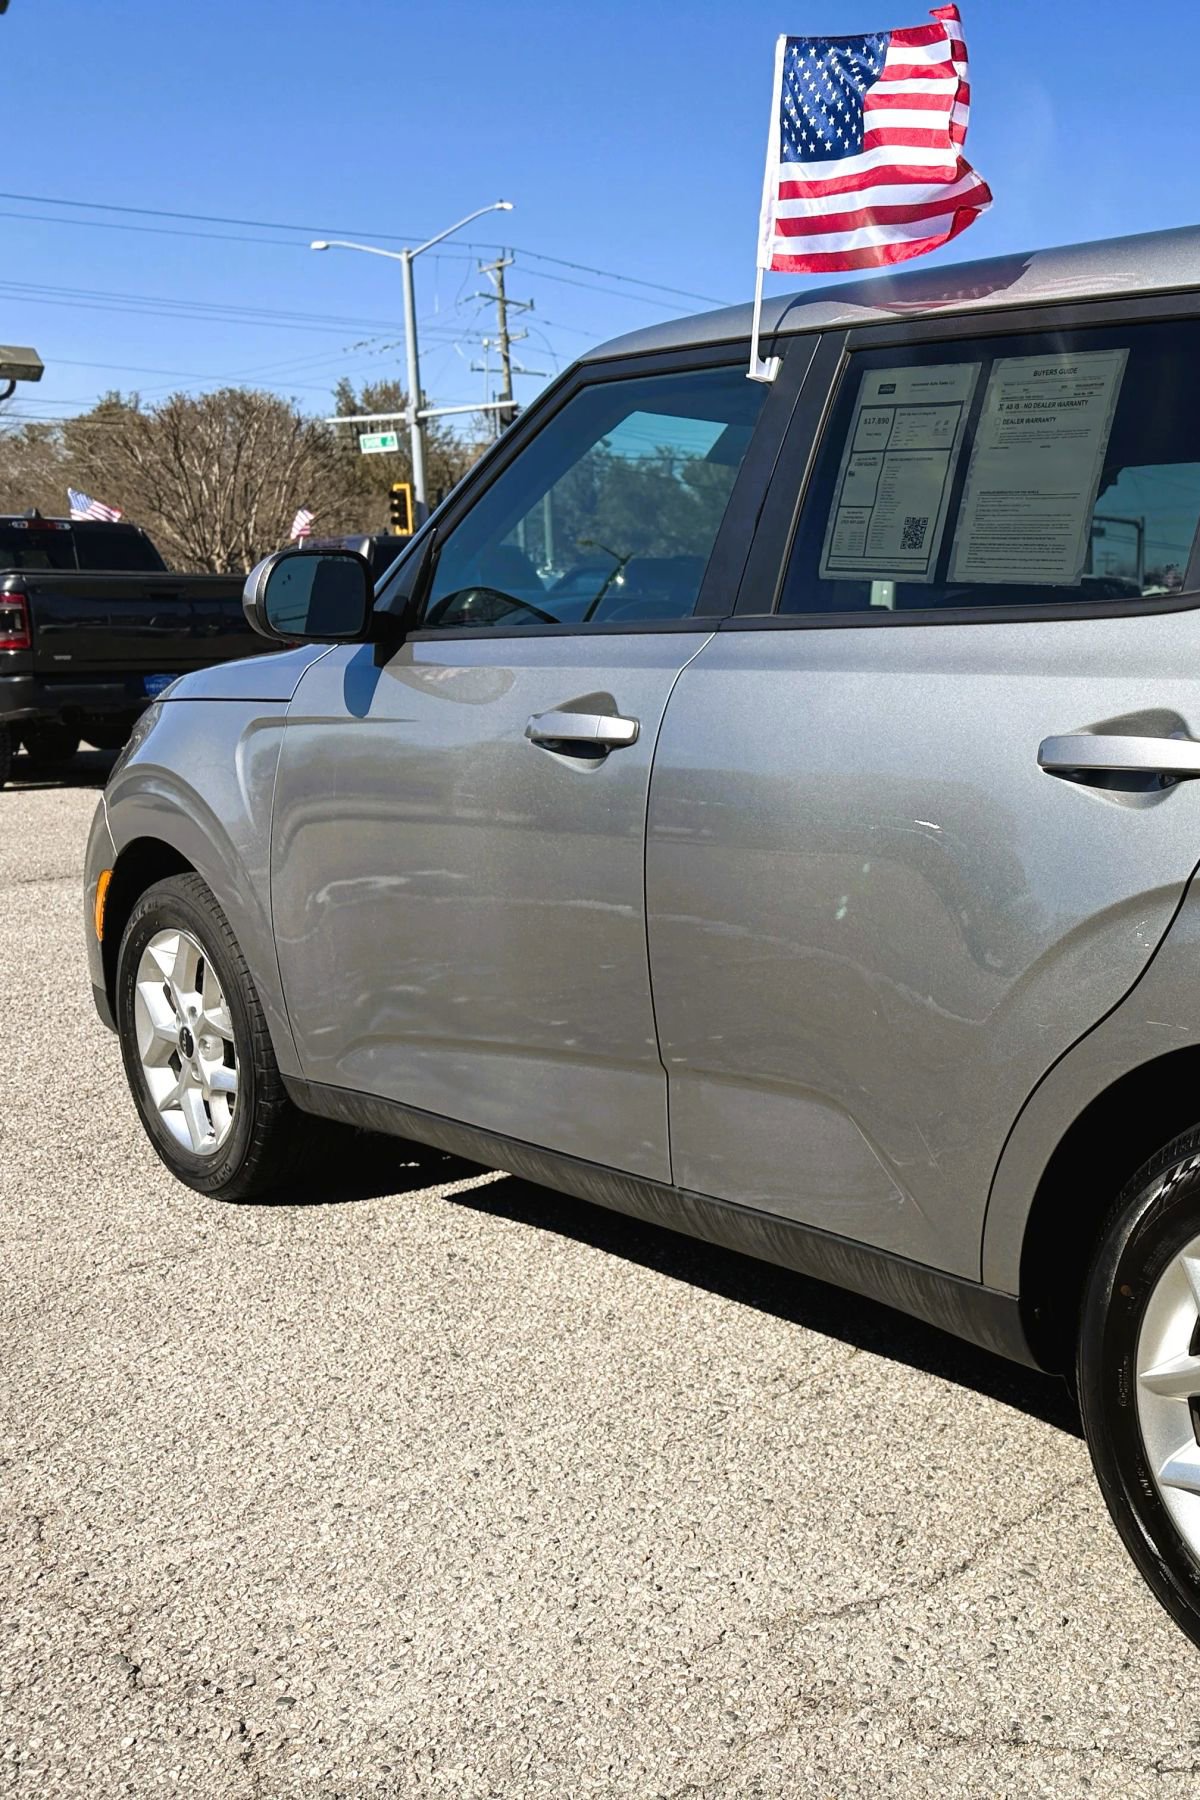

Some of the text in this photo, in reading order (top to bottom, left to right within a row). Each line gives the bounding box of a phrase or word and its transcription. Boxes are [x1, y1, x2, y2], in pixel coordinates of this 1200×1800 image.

[1033, 367, 1079, 377] BUYERS GUIDE
[1033, 401, 1056, 409] DEALER
[1057, 399, 1089, 408] WARRANTY
[1002, 416, 1056, 426] DEALER WARRANTY
